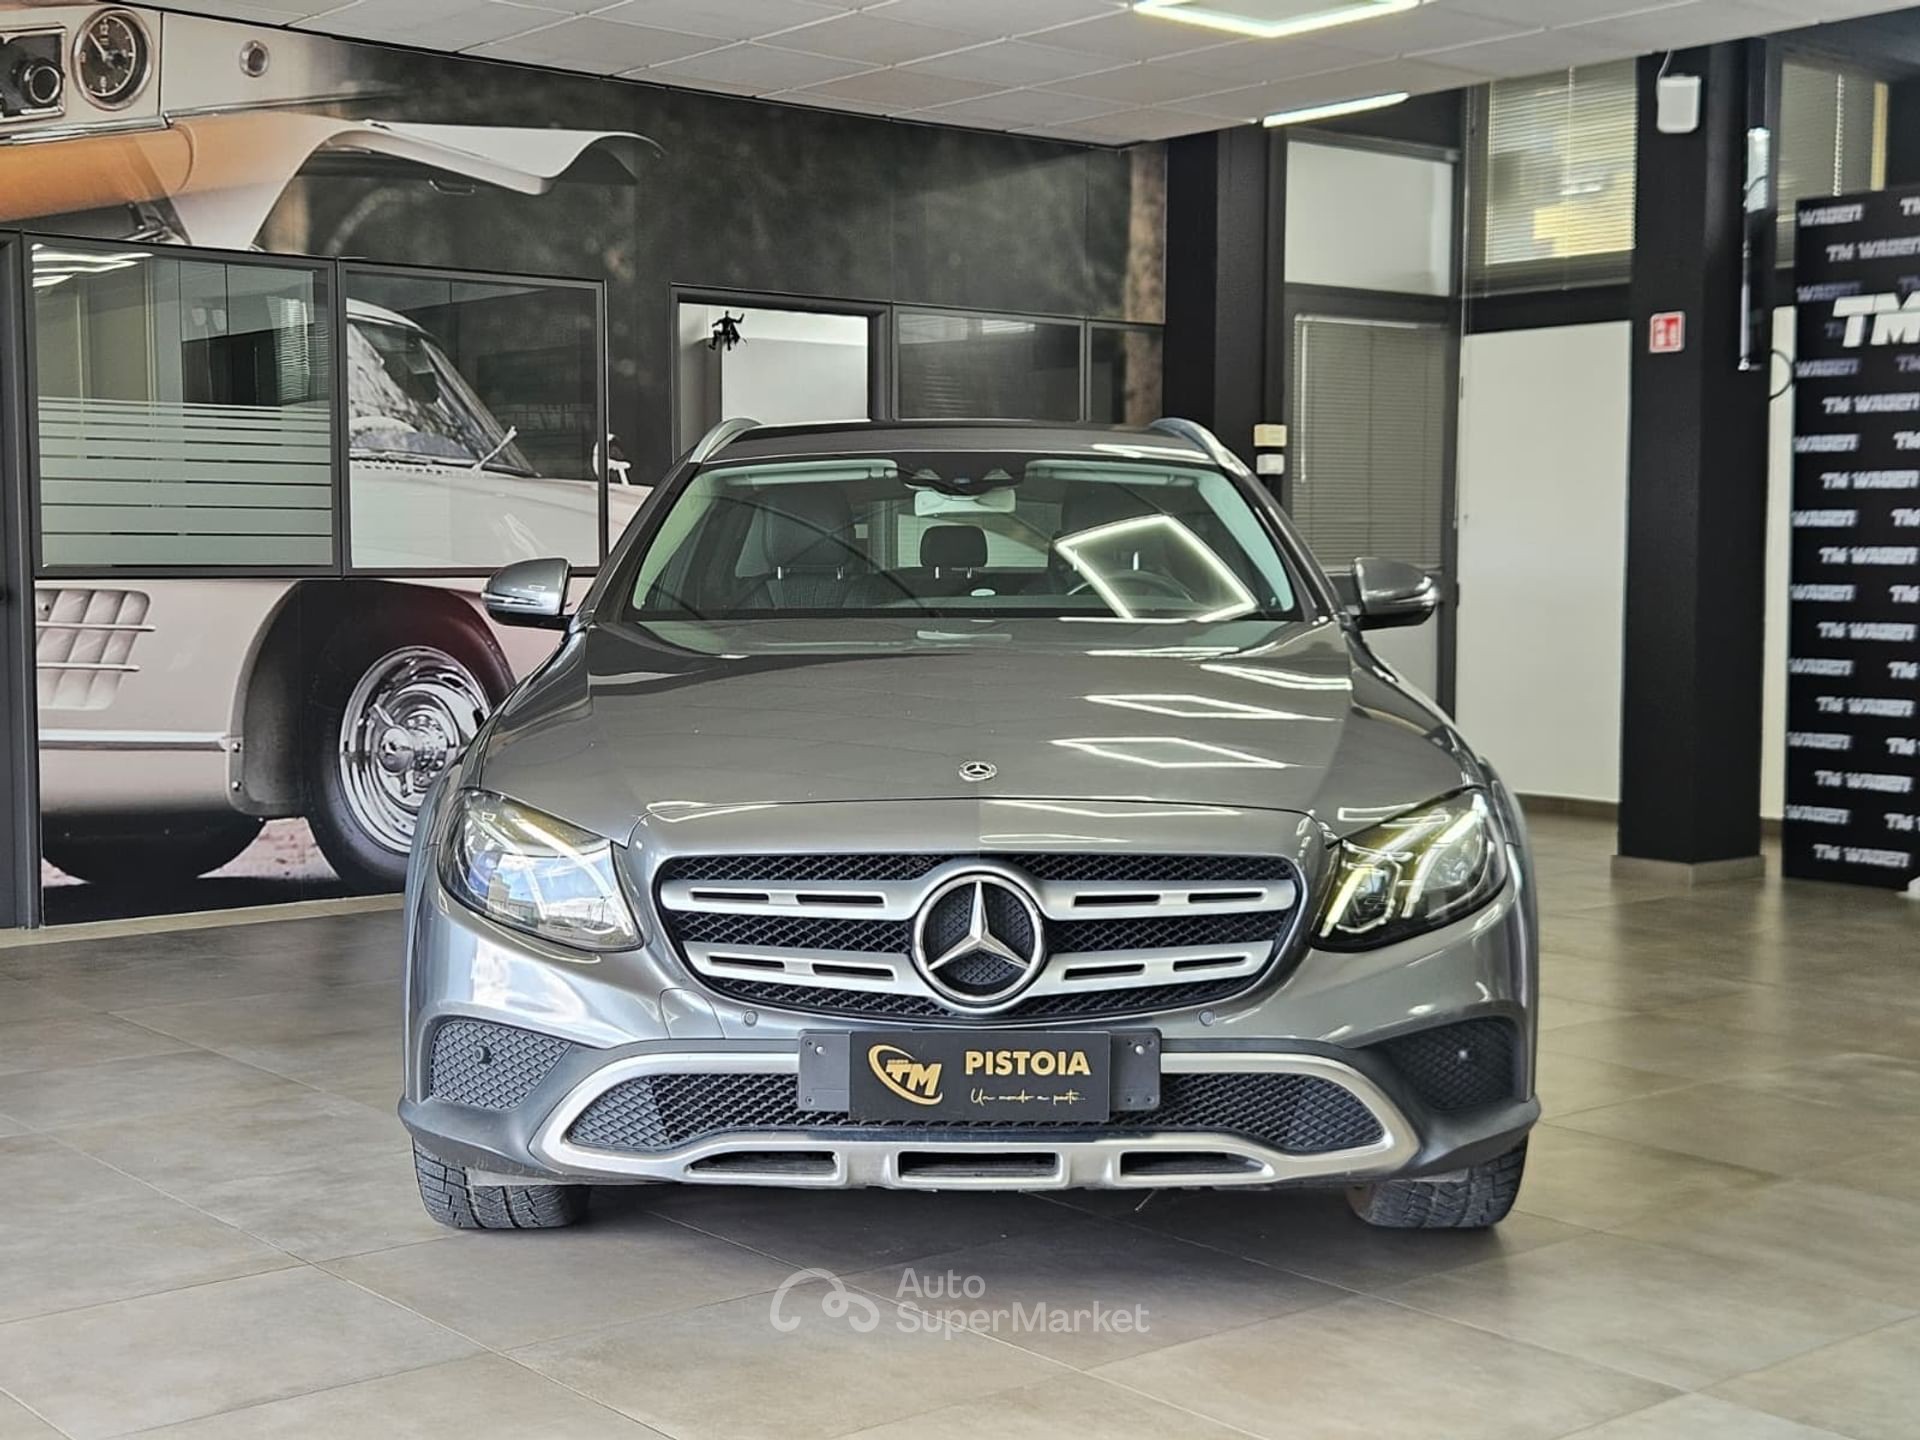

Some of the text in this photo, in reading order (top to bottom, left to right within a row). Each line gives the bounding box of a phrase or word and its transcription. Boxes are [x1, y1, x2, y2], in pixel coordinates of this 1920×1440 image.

[1826, 243, 1855, 262] TM
[1833, 290, 1920, 348] TM
[1822, 396, 1851, 414] TM
[1821, 471, 1850, 489] TM
[1819, 547, 1848, 564] TM
[1817, 622, 1847, 639] TM
[1816, 696, 1844, 713] TM
[1814, 770, 1842, 787] TM
[1813, 843, 1841, 860] TM
[965, 1051, 1092, 1076] PISTOIA
[885, 1062, 942, 1096] TM
